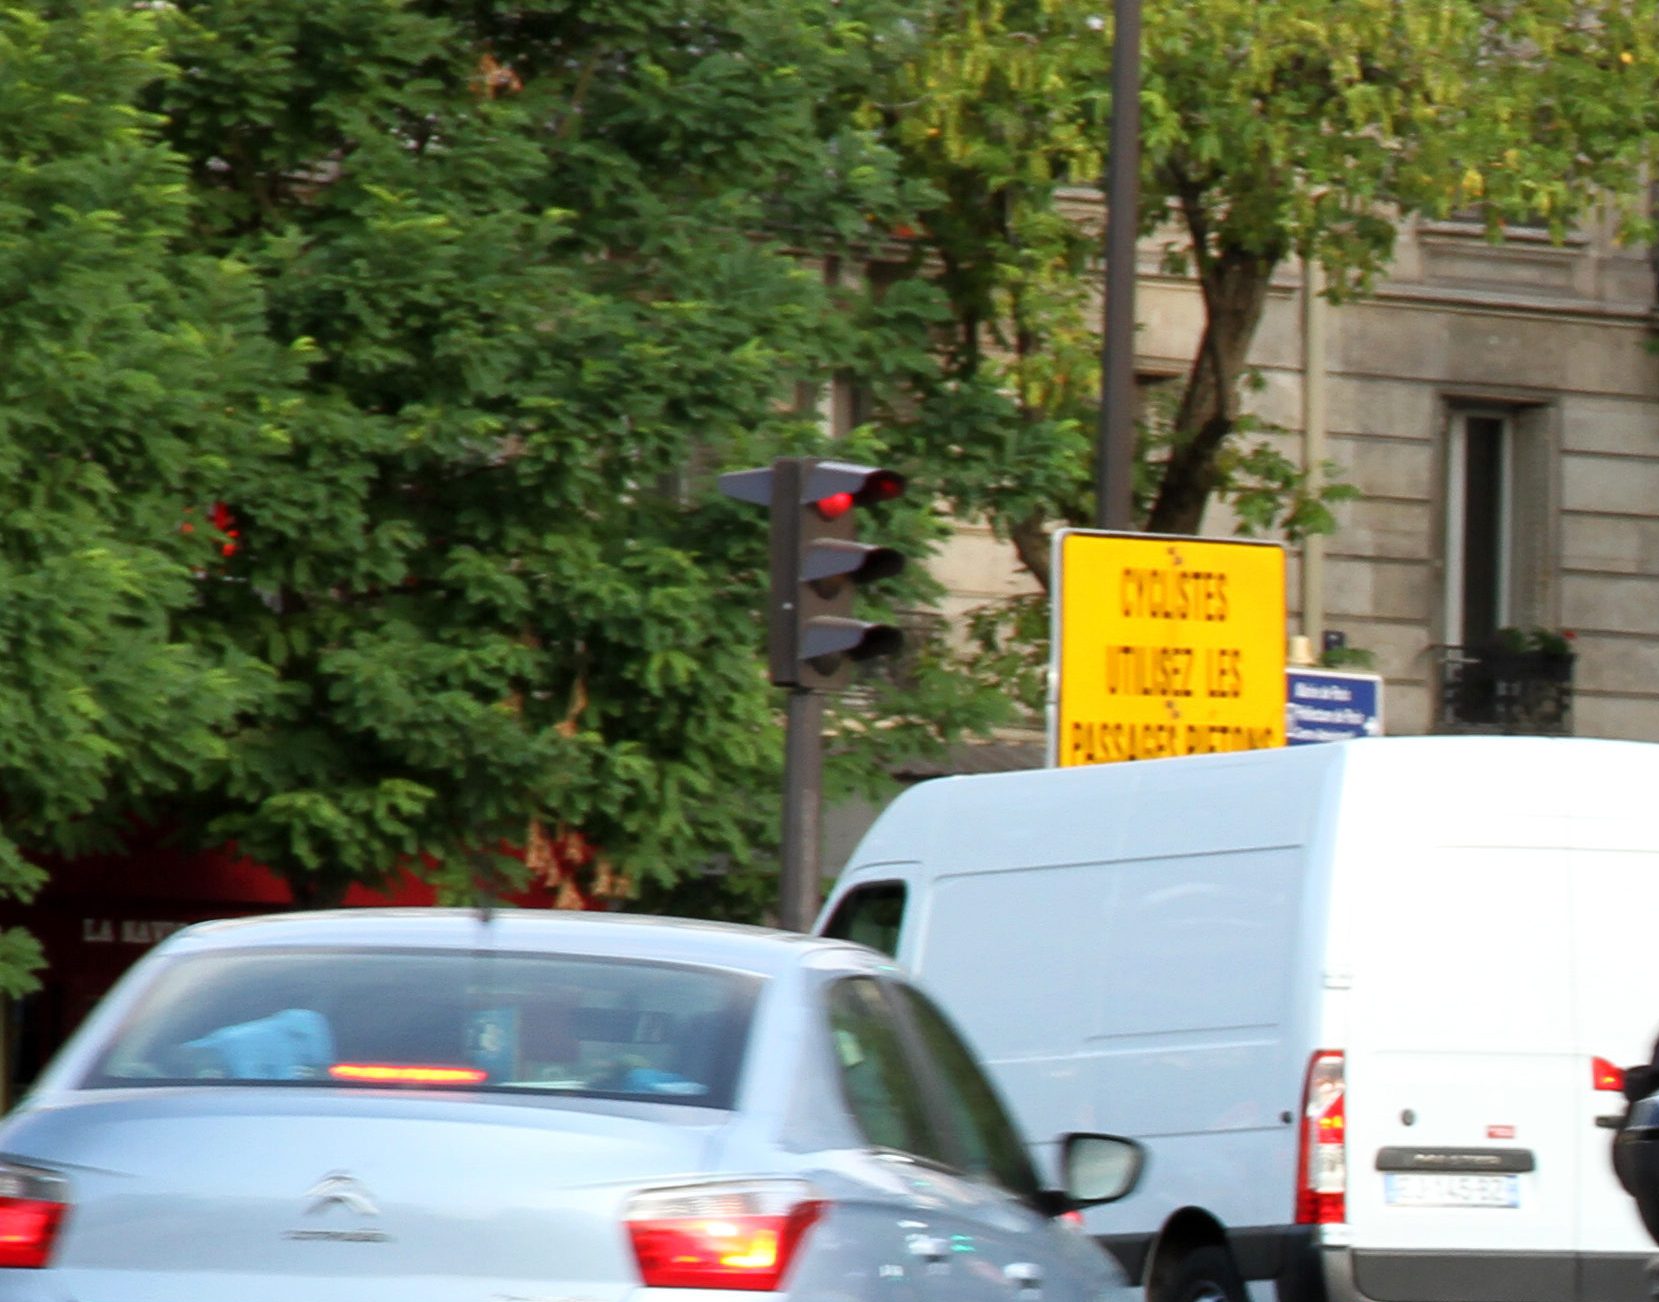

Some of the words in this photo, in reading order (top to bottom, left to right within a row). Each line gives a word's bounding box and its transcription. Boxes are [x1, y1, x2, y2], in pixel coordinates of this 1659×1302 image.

[1120, 568, 1228, 621] CYCLISTES
[1105, 645, 1193, 696] UTILISEZ
[1205, 648, 1243, 698] LES
[1071, 721, 1177, 765] PASSAGES
